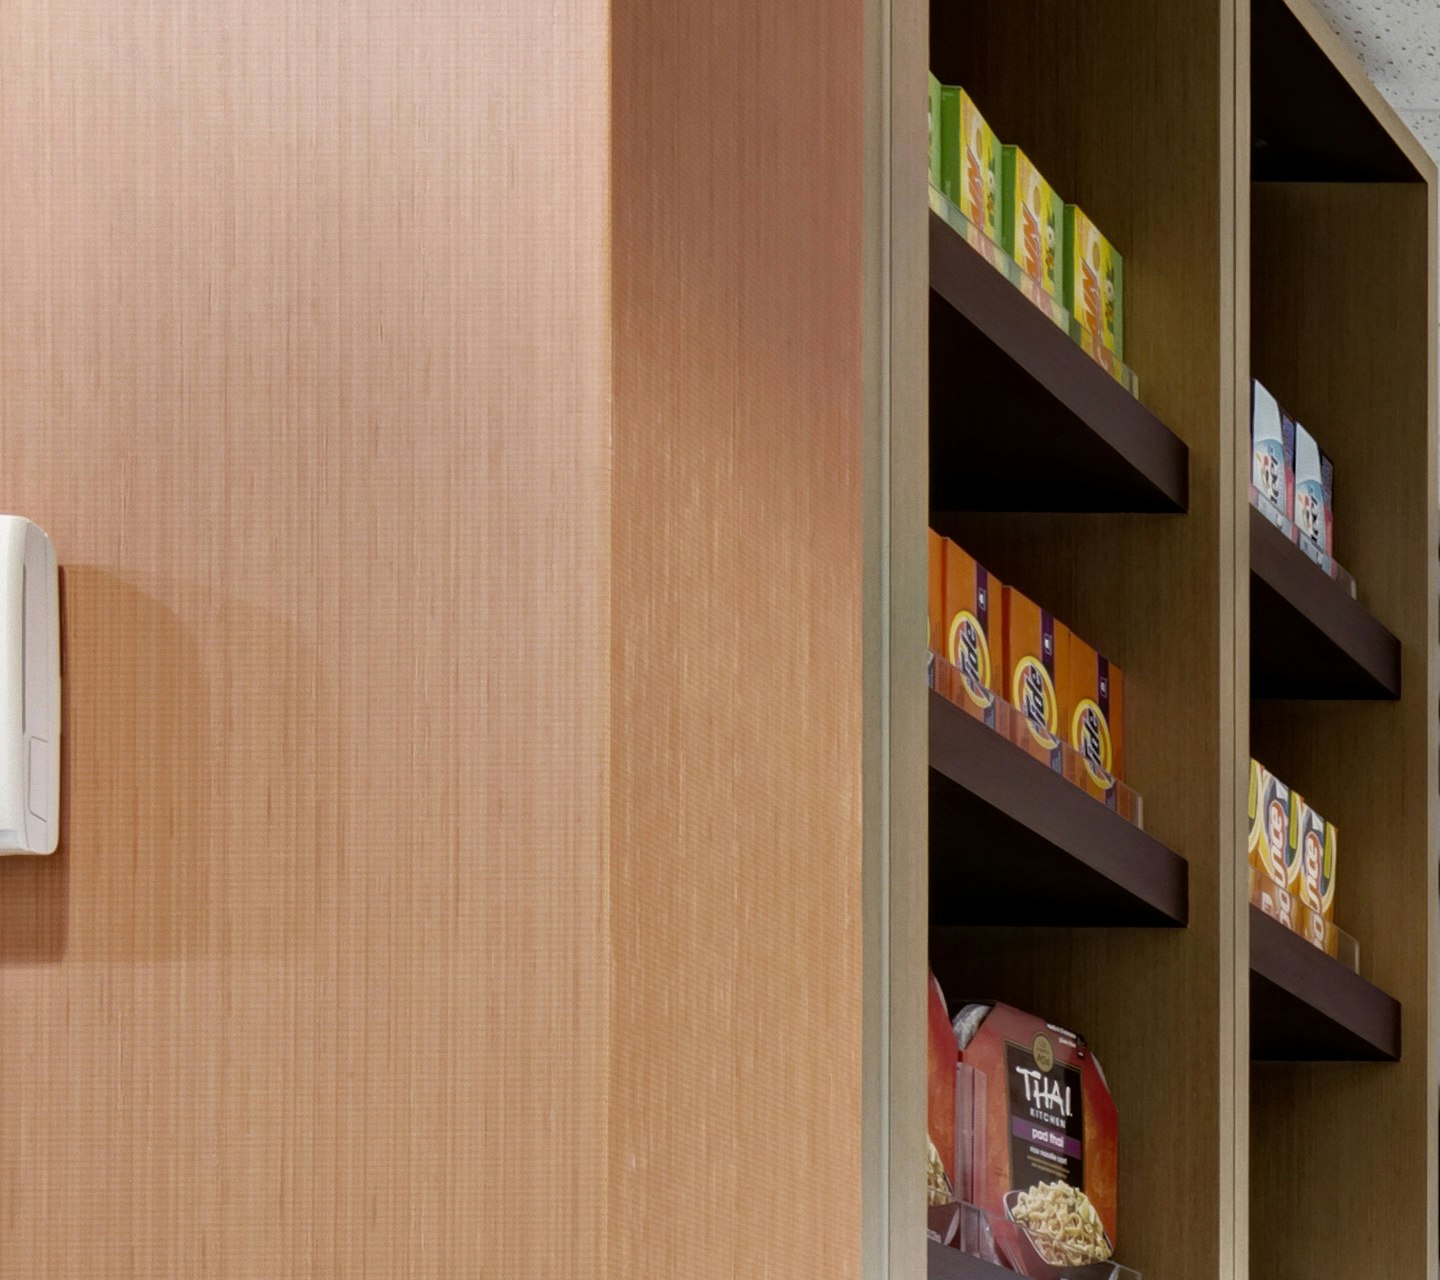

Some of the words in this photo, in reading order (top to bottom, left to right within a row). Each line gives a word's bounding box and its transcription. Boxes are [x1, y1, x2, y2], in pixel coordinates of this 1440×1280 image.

[1016, 1066, 1072, 1117] THAI
[1030, 1107, 1066, 1129] KITCHEN
[1032, 1128, 1049, 1142] pad
[1050, 1131, 1064, 1148] thai
